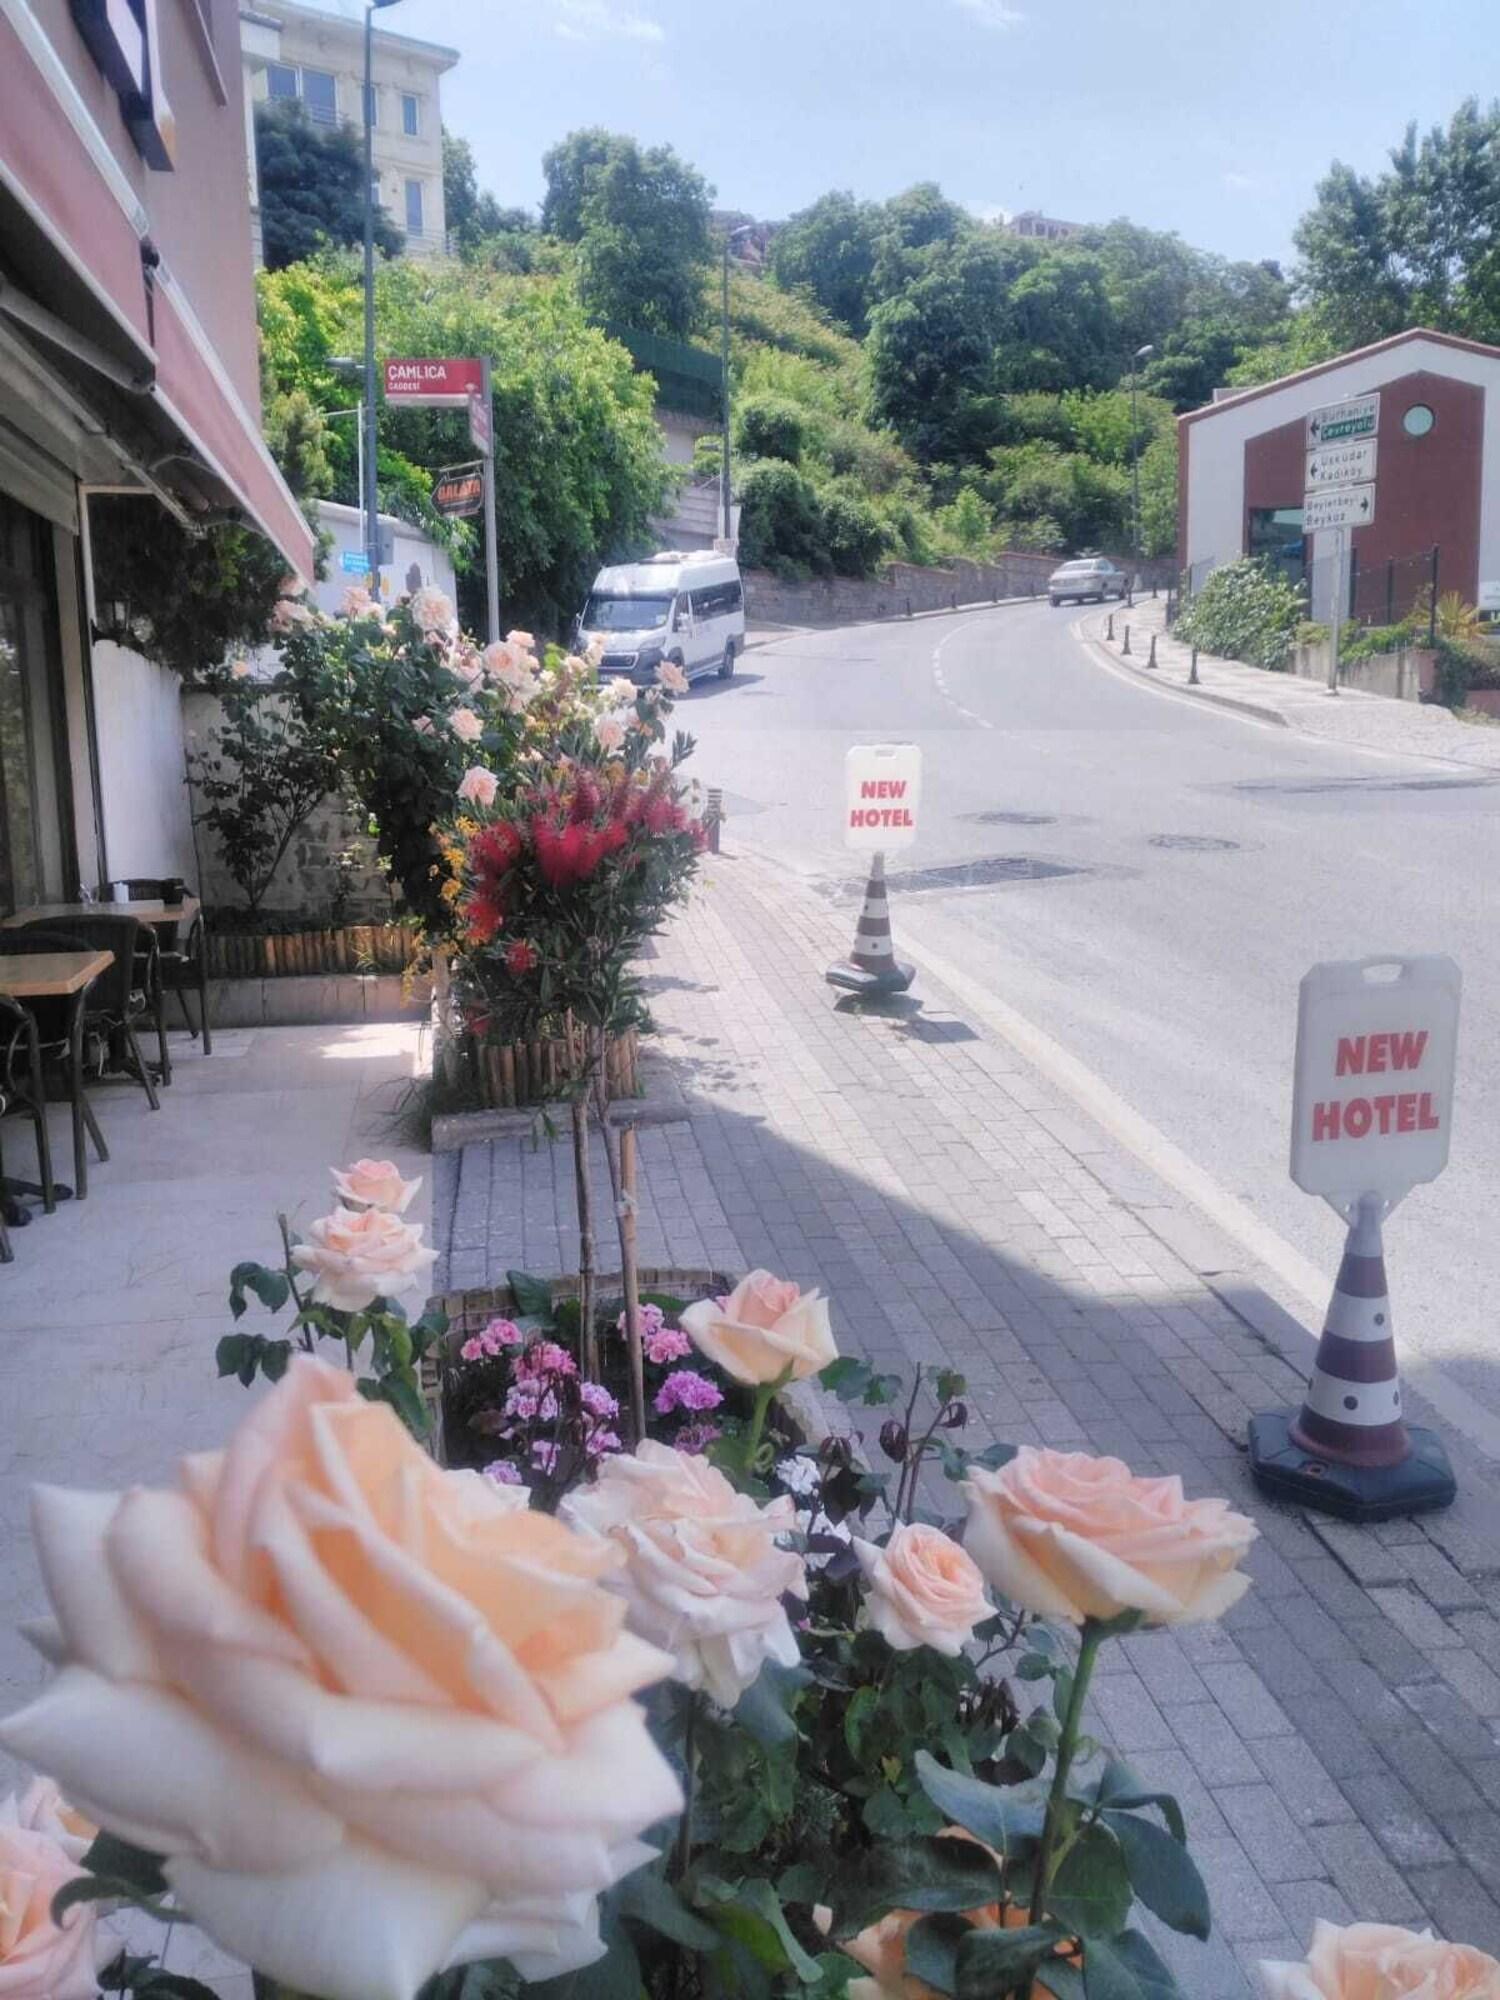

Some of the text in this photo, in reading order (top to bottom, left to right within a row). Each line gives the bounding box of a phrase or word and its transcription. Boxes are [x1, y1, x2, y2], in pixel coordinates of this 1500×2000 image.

[388, 365, 447, 380] ÇAMLICA
[861, 780, 907, 799] NEW
[850, 808, 913, 828] HOTEL
[1334, 1030, 1429, 1077] NEW
[1312, 1092, 1440, 1142] HOTEL
